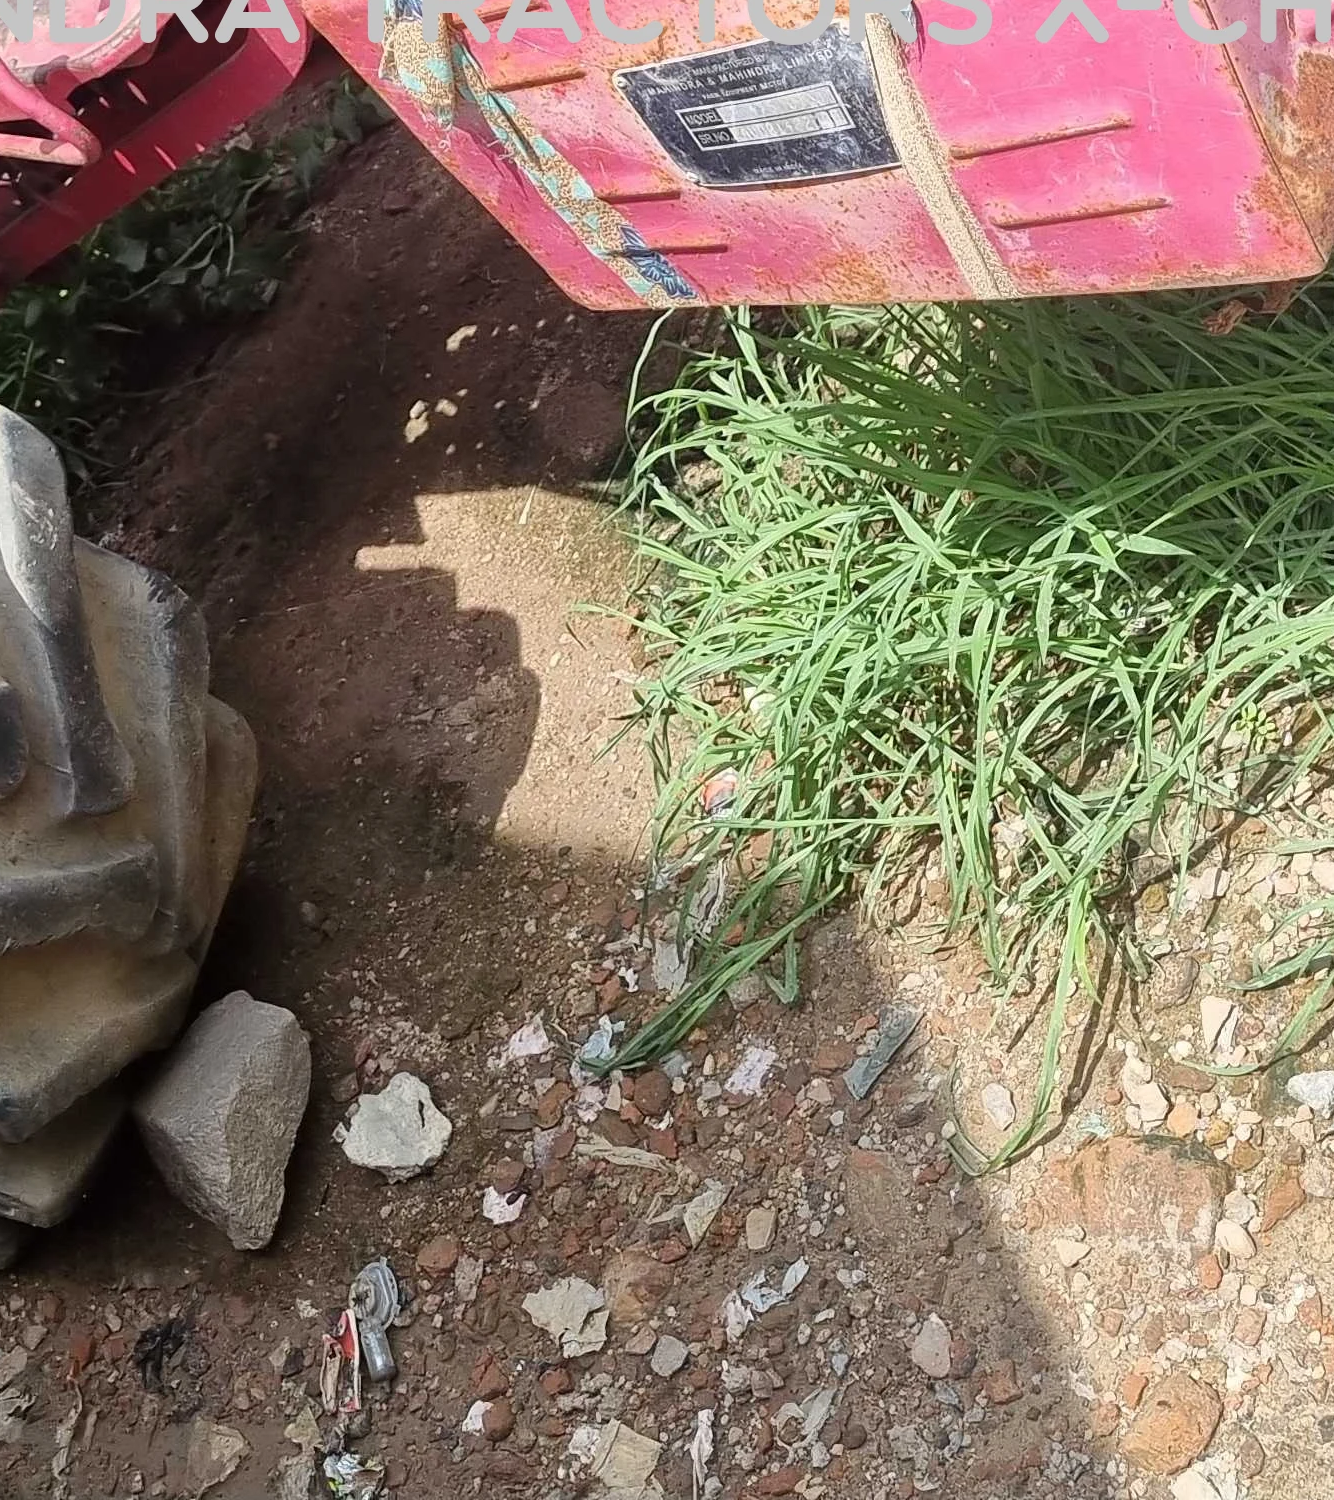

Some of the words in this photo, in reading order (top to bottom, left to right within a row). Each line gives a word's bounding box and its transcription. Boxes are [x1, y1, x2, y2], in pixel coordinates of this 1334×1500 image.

[719, 63, 783, 84] MAHINDRA
[784, 49, 835, 69] LIMITED
[684, 109, 721, 127] MODEL
